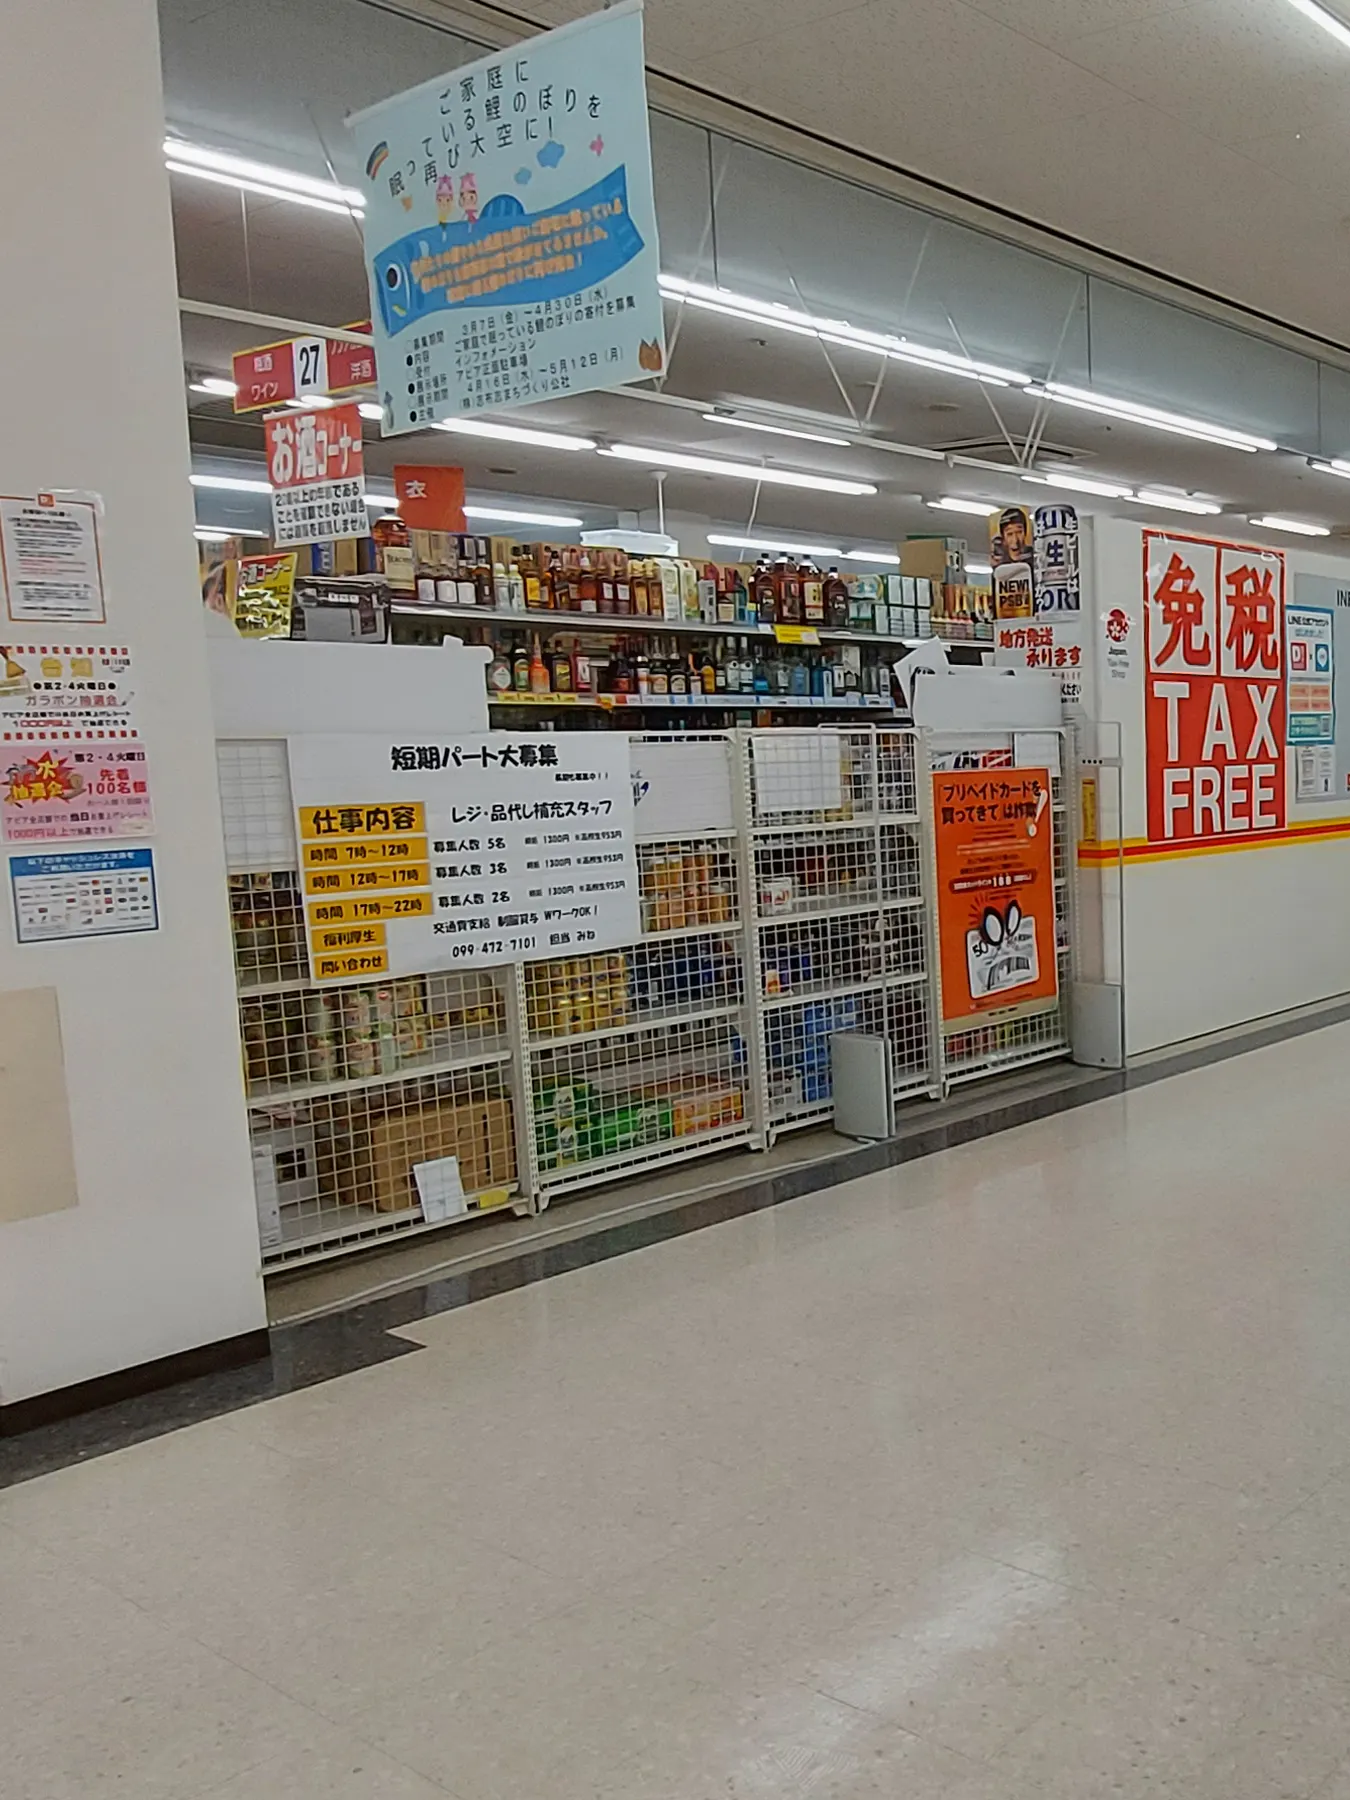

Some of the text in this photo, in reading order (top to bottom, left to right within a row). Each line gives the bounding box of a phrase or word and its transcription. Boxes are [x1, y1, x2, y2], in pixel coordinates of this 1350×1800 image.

[439, 60, 529, 115] ご家庭に
[300, 344, 320, 386] 27
[251, 381, 279, 402] ワイン
[1153, 551, 1279, 673] 免税
[999, 626, 1053, 649] 地方発送
[1026, 646, 1082, 668] 承ります
[1153, 680, 1279, 763] TAX
[391, 744, 559, 771] 短期パート大募集
[1163, 763, 1277, 838] FREE
[312, 805, 416, 835] 仕事内容
[310, 847, 338, 862] 時間
[312, 874, 341, 889] 時間
[315, 905, 344, 920] 時間
[323, 929, 376, 947] 福利厚生
[452, 936, 536, 958] 099-472-7101
[549, 932, 571, 946] 担当
[321, 955, 383, 974] 問い合わせ
